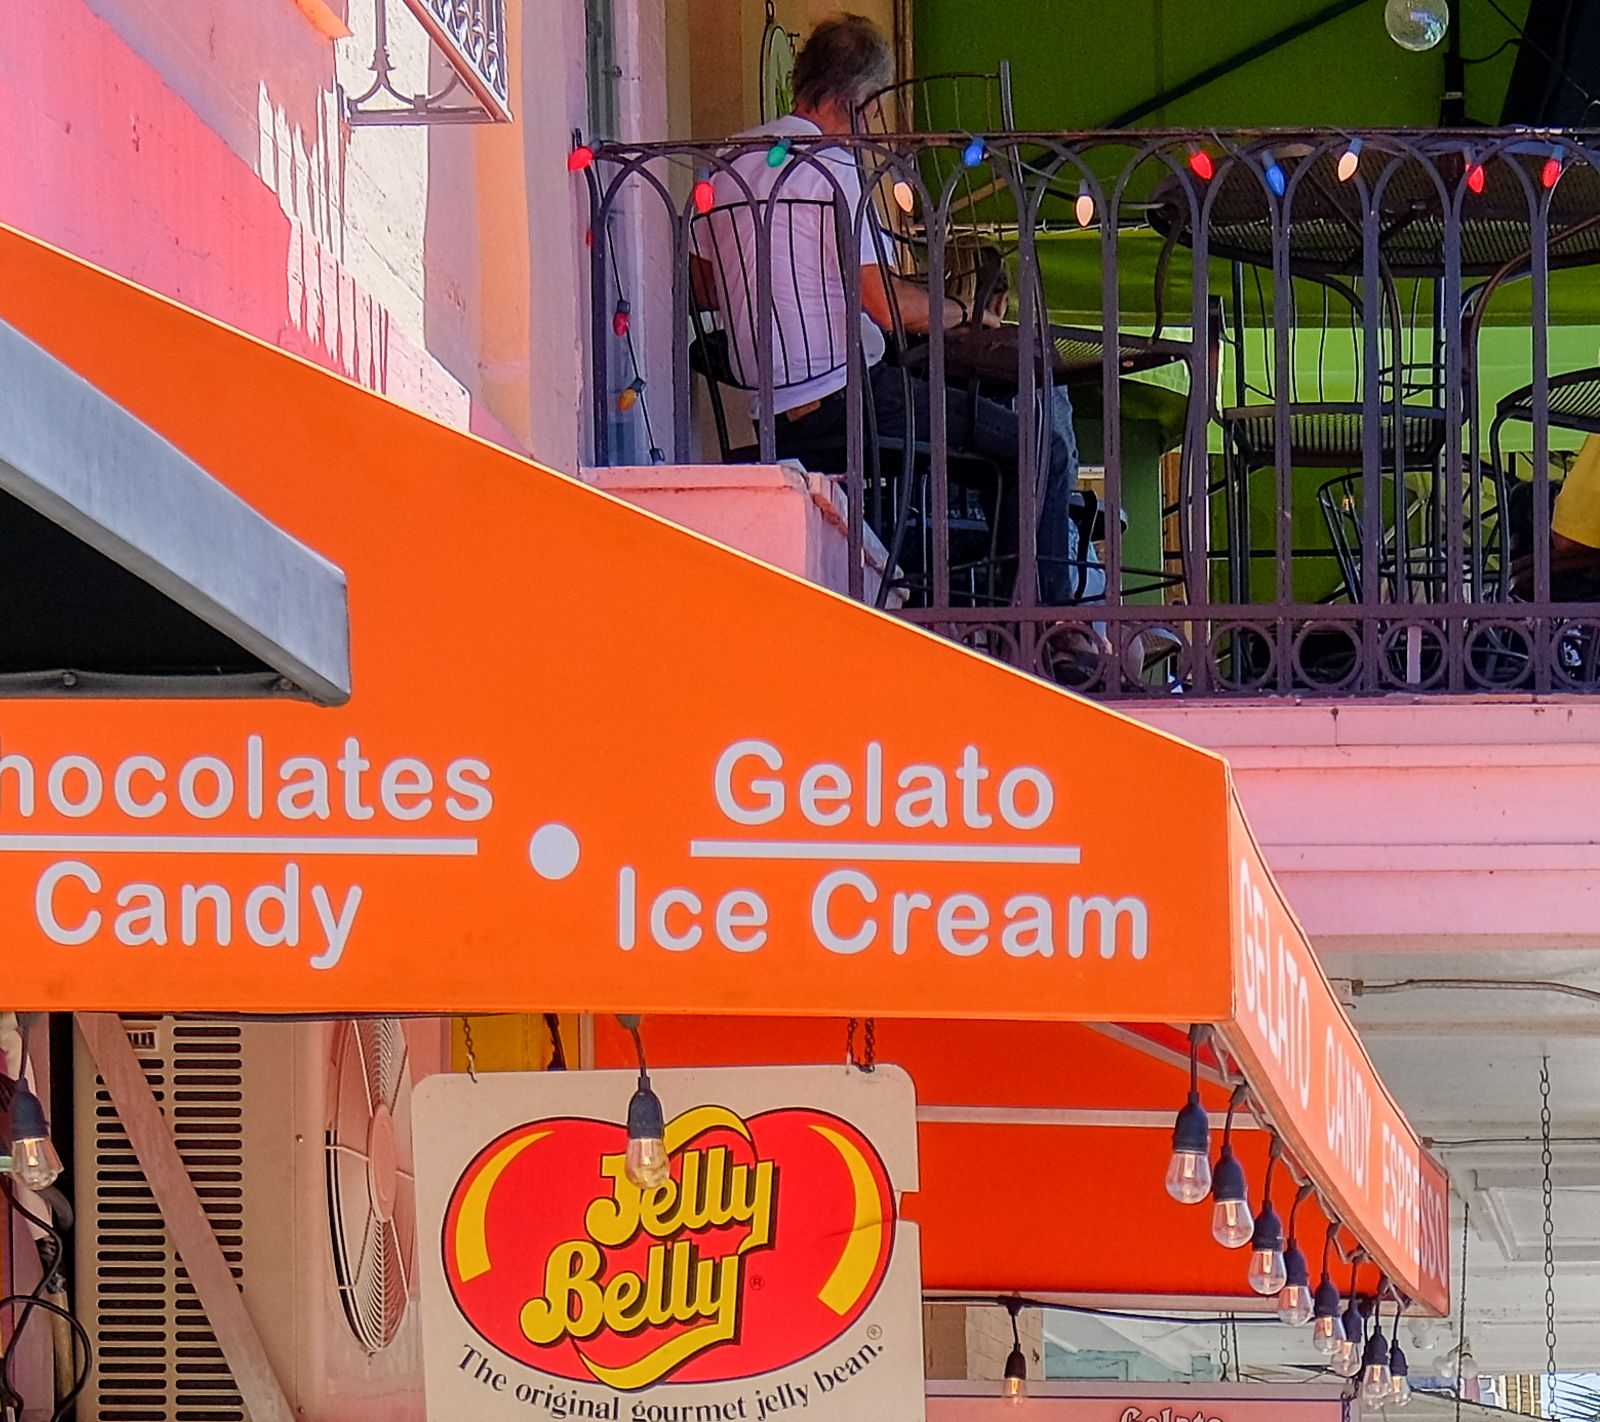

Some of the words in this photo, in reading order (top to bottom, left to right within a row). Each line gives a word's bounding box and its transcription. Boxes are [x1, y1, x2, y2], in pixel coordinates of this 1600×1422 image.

[712, 741, 1055, 829] Gelato
[35, 861, 362, 970] Candy
[619, 867, 767, 953] Ice
[812, 867, 1149, 961] Cream
[1240, 857, 1311, 1110] GELATO
[1325, 1024, 1373, 1202] CANDY
[1382, 1120, 1447, 1290] ESPRESSO
[585, 1144, 777, 1256] Jelly
[519, 1239, 743, 1352] Belly
[458, 1343, 508, 1393] The
[516, 1383, 619, 1421] original
[757, 1382, 810, 1422] jelly
